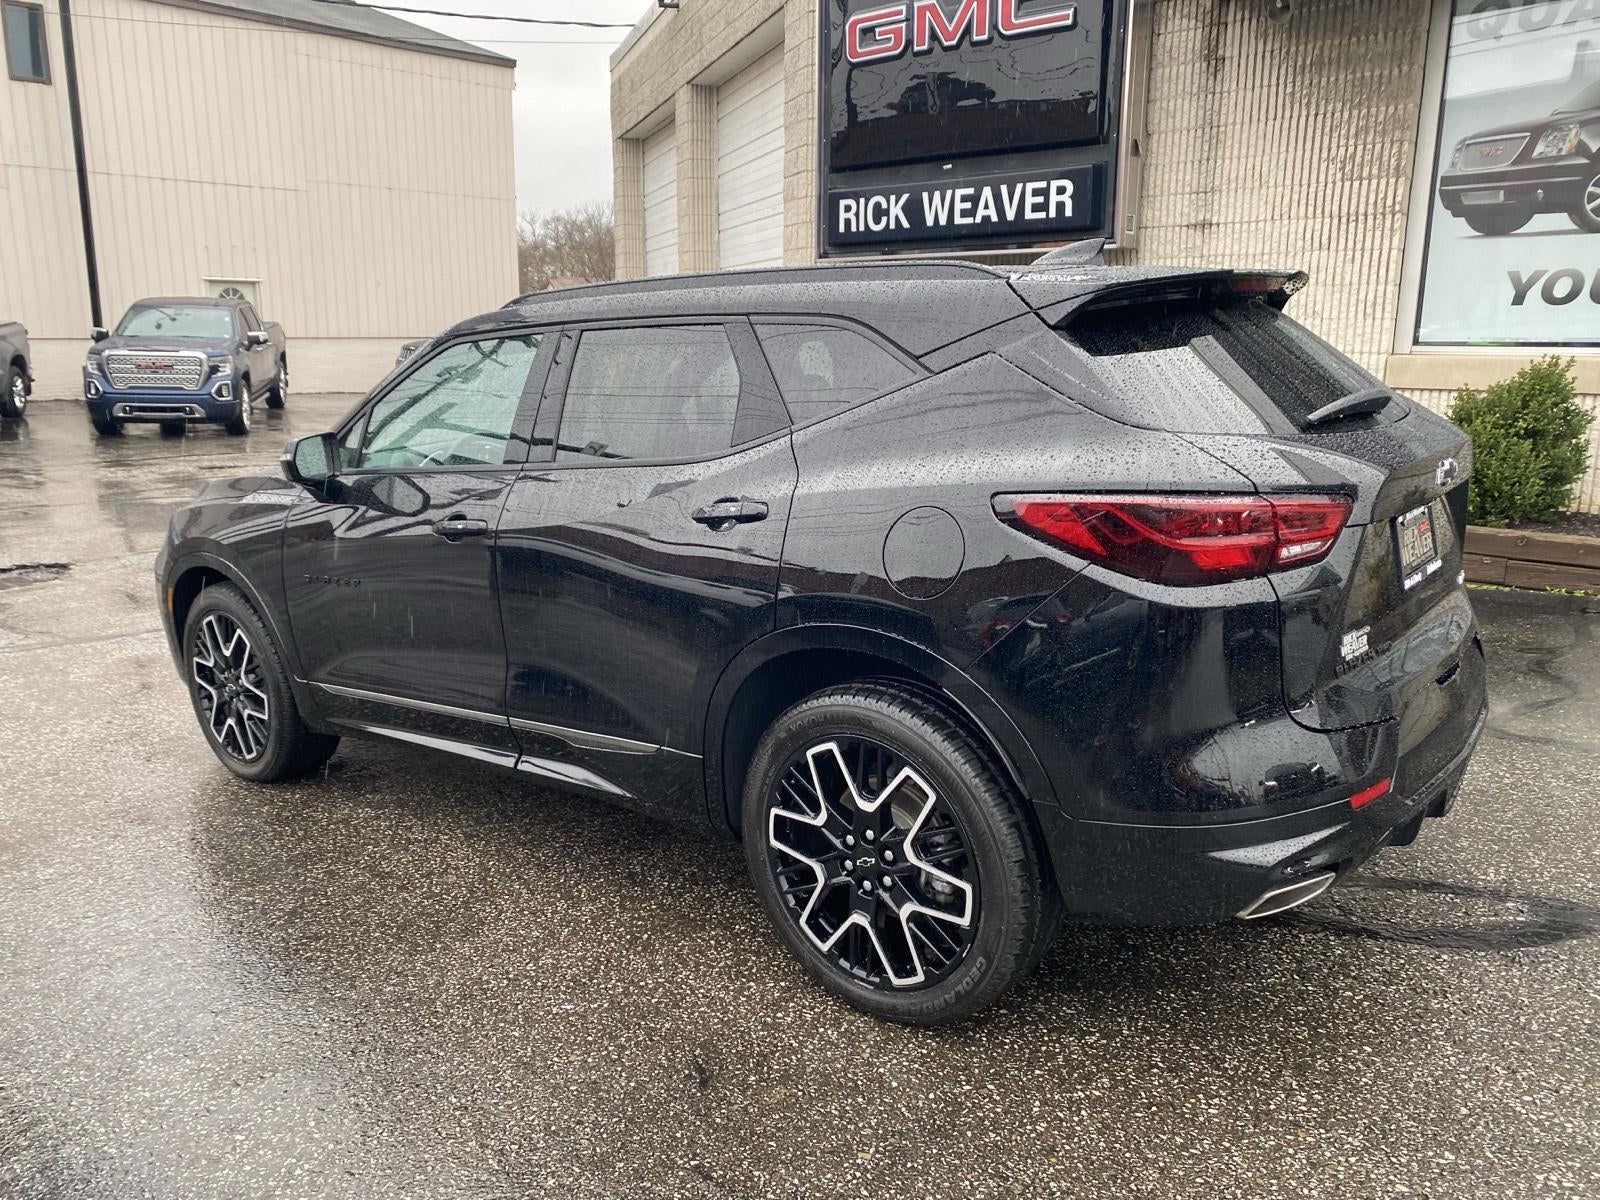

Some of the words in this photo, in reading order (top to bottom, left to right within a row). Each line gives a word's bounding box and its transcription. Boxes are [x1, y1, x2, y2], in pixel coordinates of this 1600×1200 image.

[846, 0, 1077, 62] GMC
[838, 193, 910, 233] RICK
[922, 178, 1074, 226] WEAVER
[1507, 268, 1600, 306] YO
[1402, 531, 1433, 567] WEAVER
[1340, 634, 1369, 657] WEAVER
